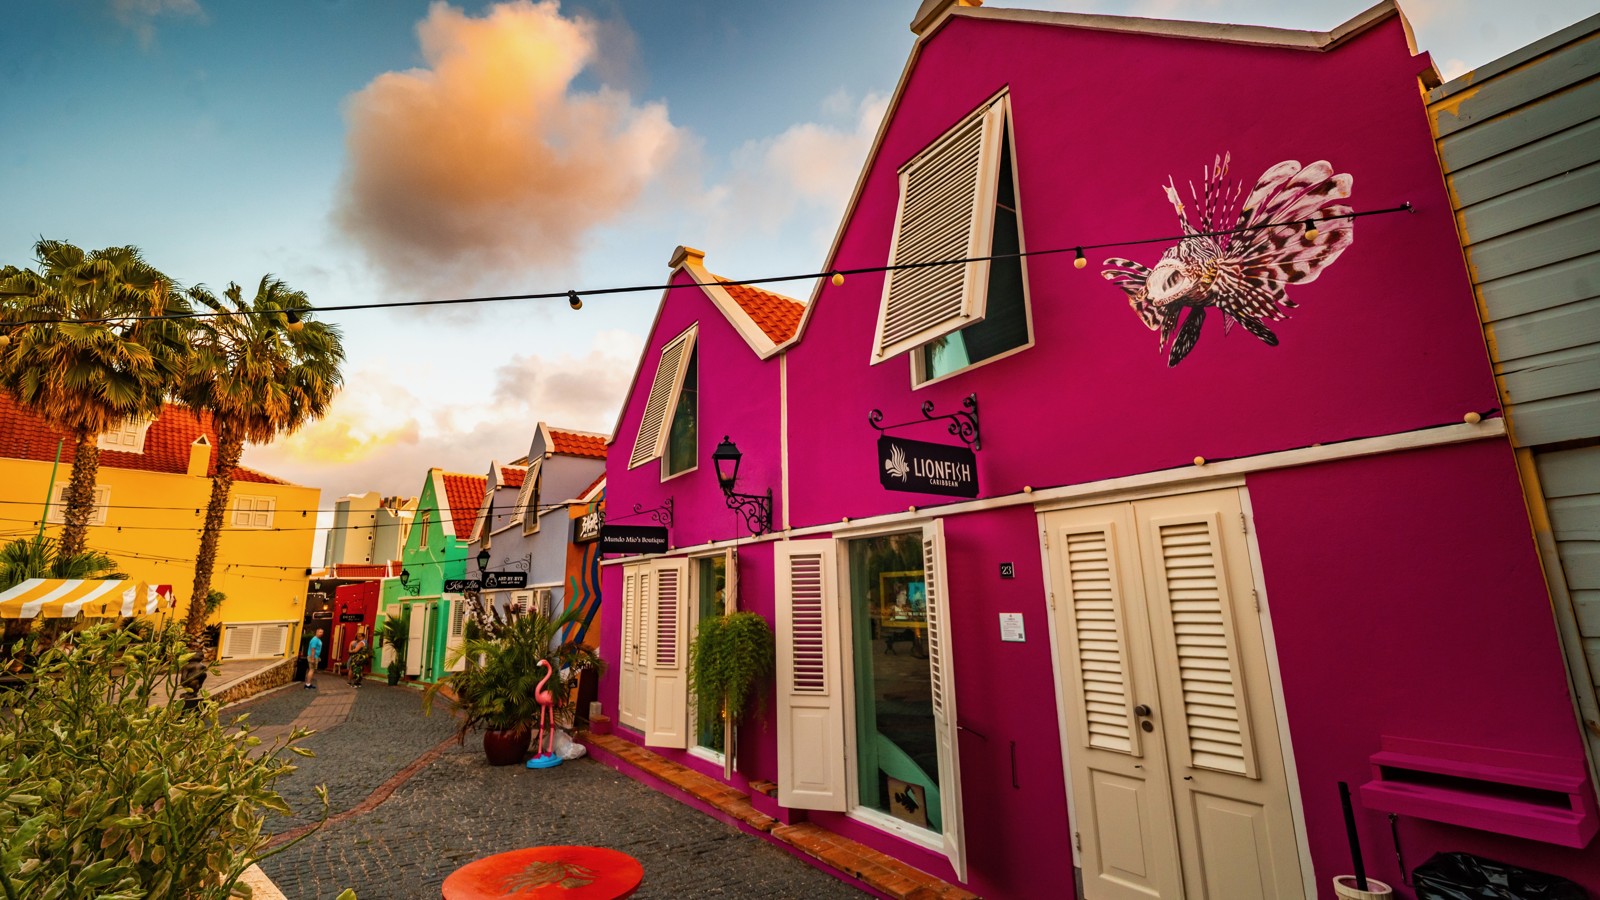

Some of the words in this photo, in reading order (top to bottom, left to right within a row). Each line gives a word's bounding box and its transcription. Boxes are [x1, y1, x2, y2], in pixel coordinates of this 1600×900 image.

[913, 457, 971, 482] LIONFISH
[929, 478, 959, 488] CARIBBEAN
[1001, 565, 1012, 575] 23
